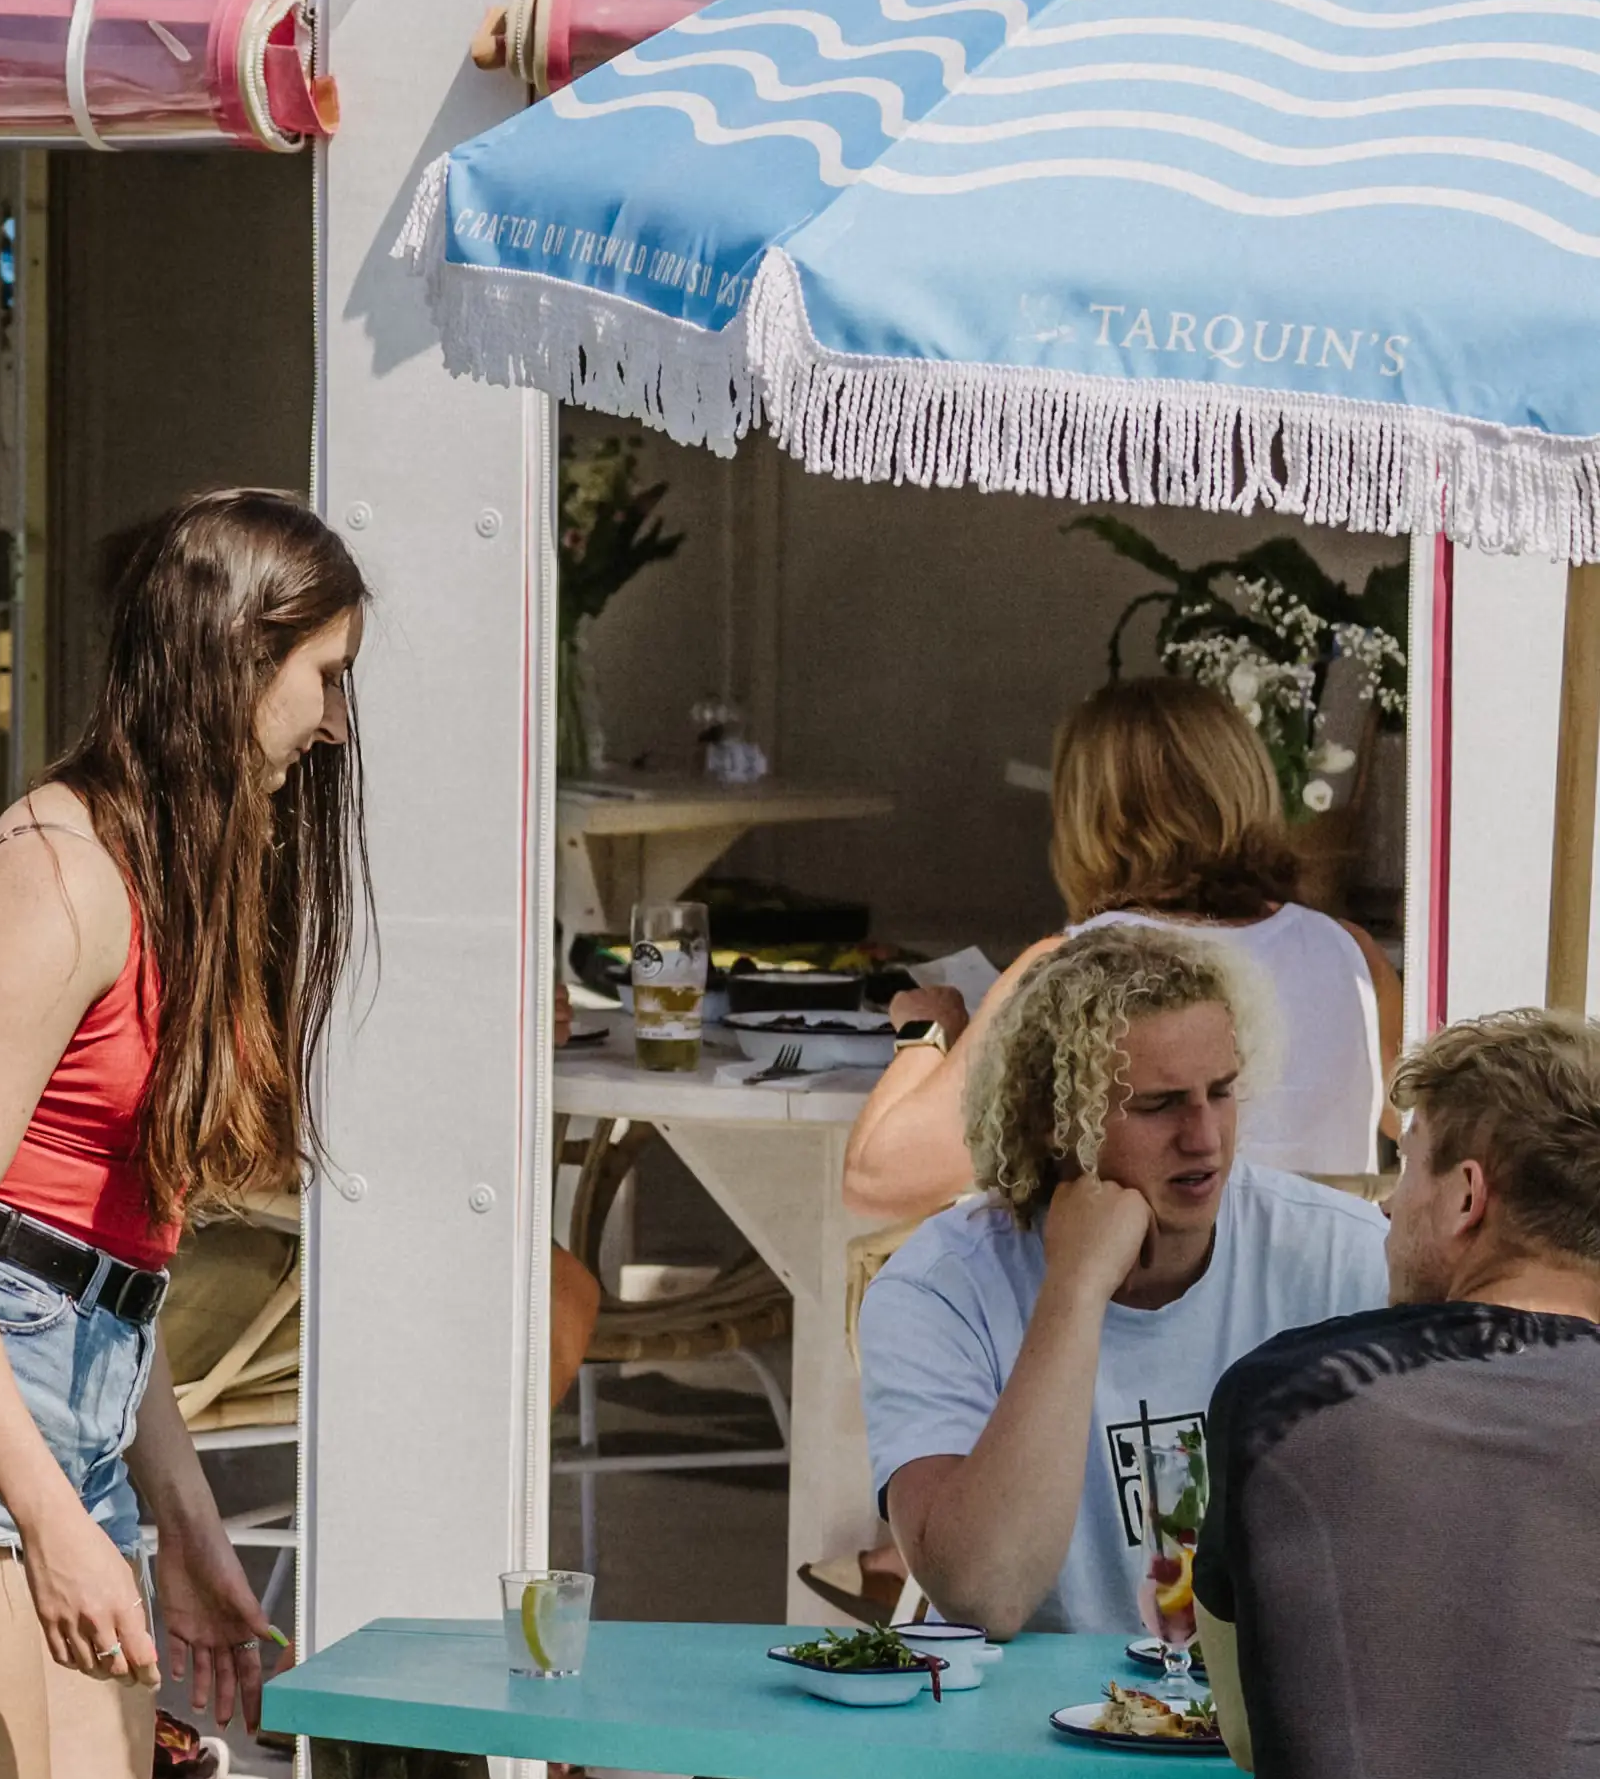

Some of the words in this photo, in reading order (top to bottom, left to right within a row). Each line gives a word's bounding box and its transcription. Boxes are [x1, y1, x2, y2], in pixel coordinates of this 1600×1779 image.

[453, 208, 537, 248] CRAFTED
[543, 224, 566, 256] ON
[570, 229, 607, 265] THE
[601, 237, 647, 275] WILD
[648, 248, 713, 297] CORNISH
[1089, 302, 1412, 378] TARQUIN'S
